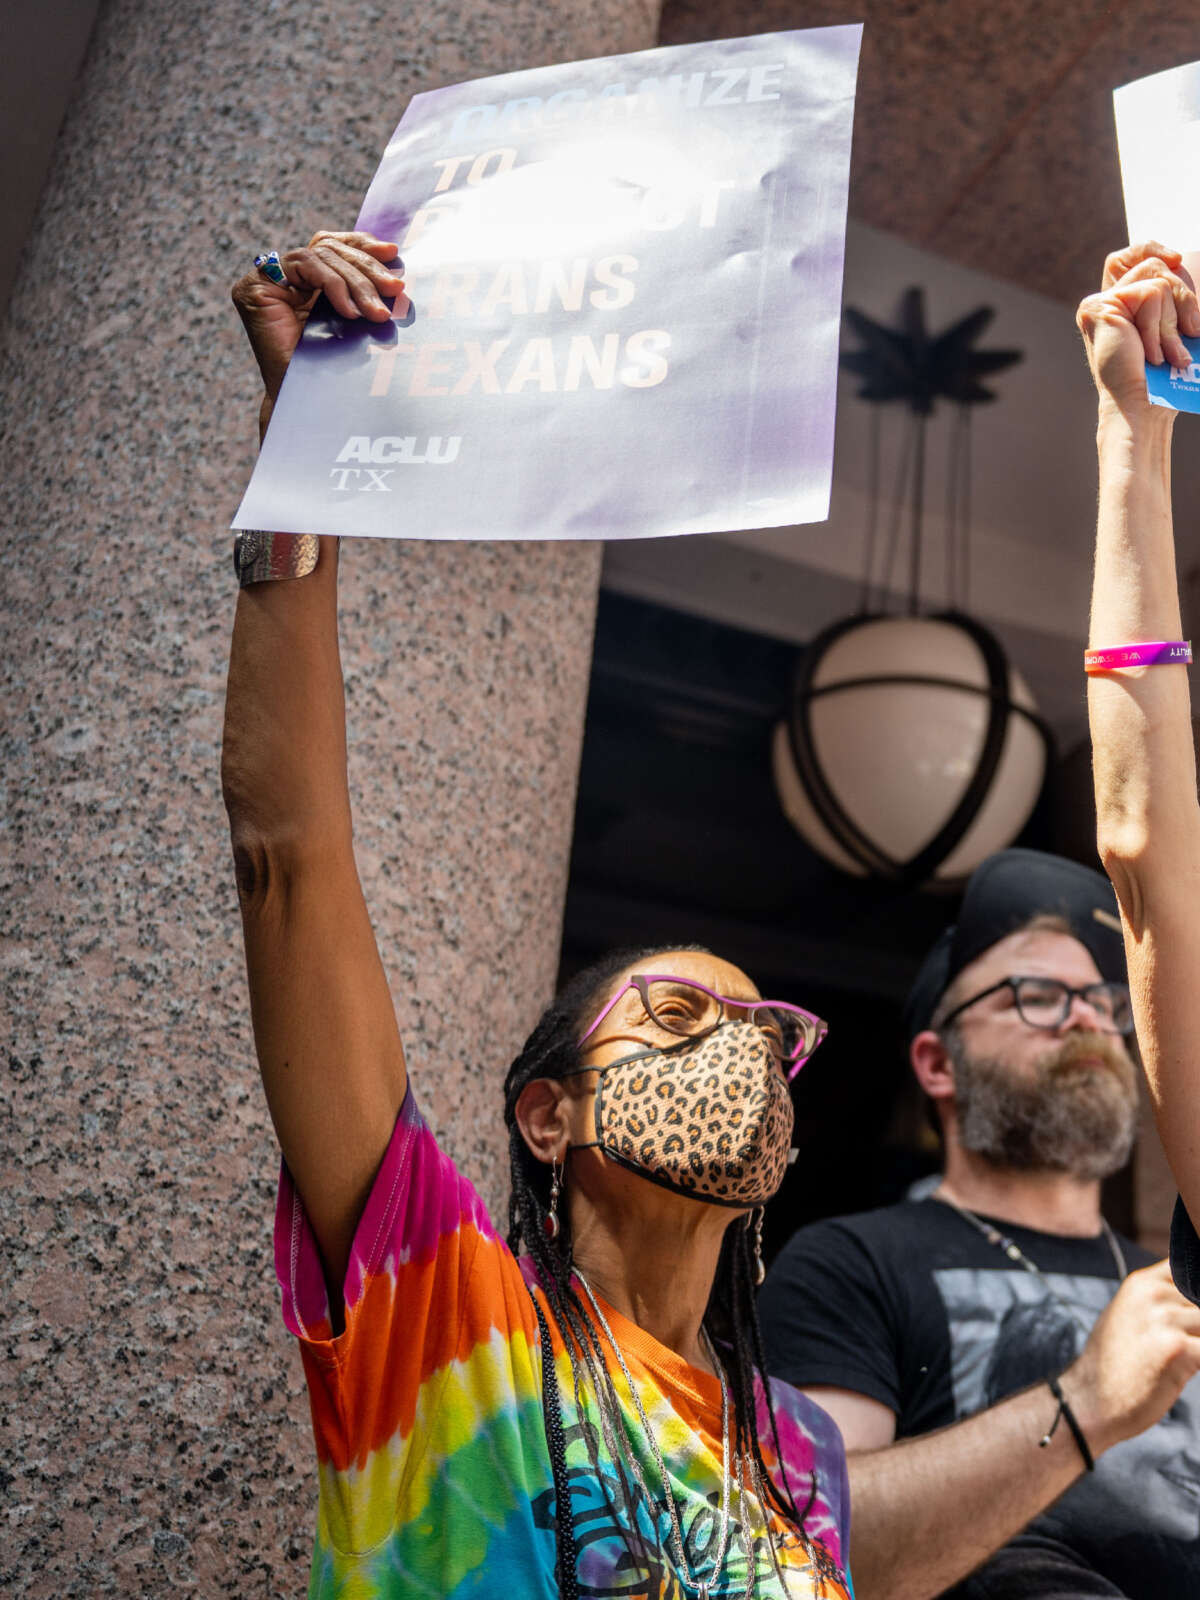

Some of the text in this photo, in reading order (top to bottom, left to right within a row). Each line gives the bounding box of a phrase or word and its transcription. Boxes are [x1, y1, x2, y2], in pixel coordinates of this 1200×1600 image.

[433, 147, 517, 193] TO
[366, 329, 671, 398] TEXANS
[335, 435, 463, 465] ACLU
[329, 468, 395, 492] TX
